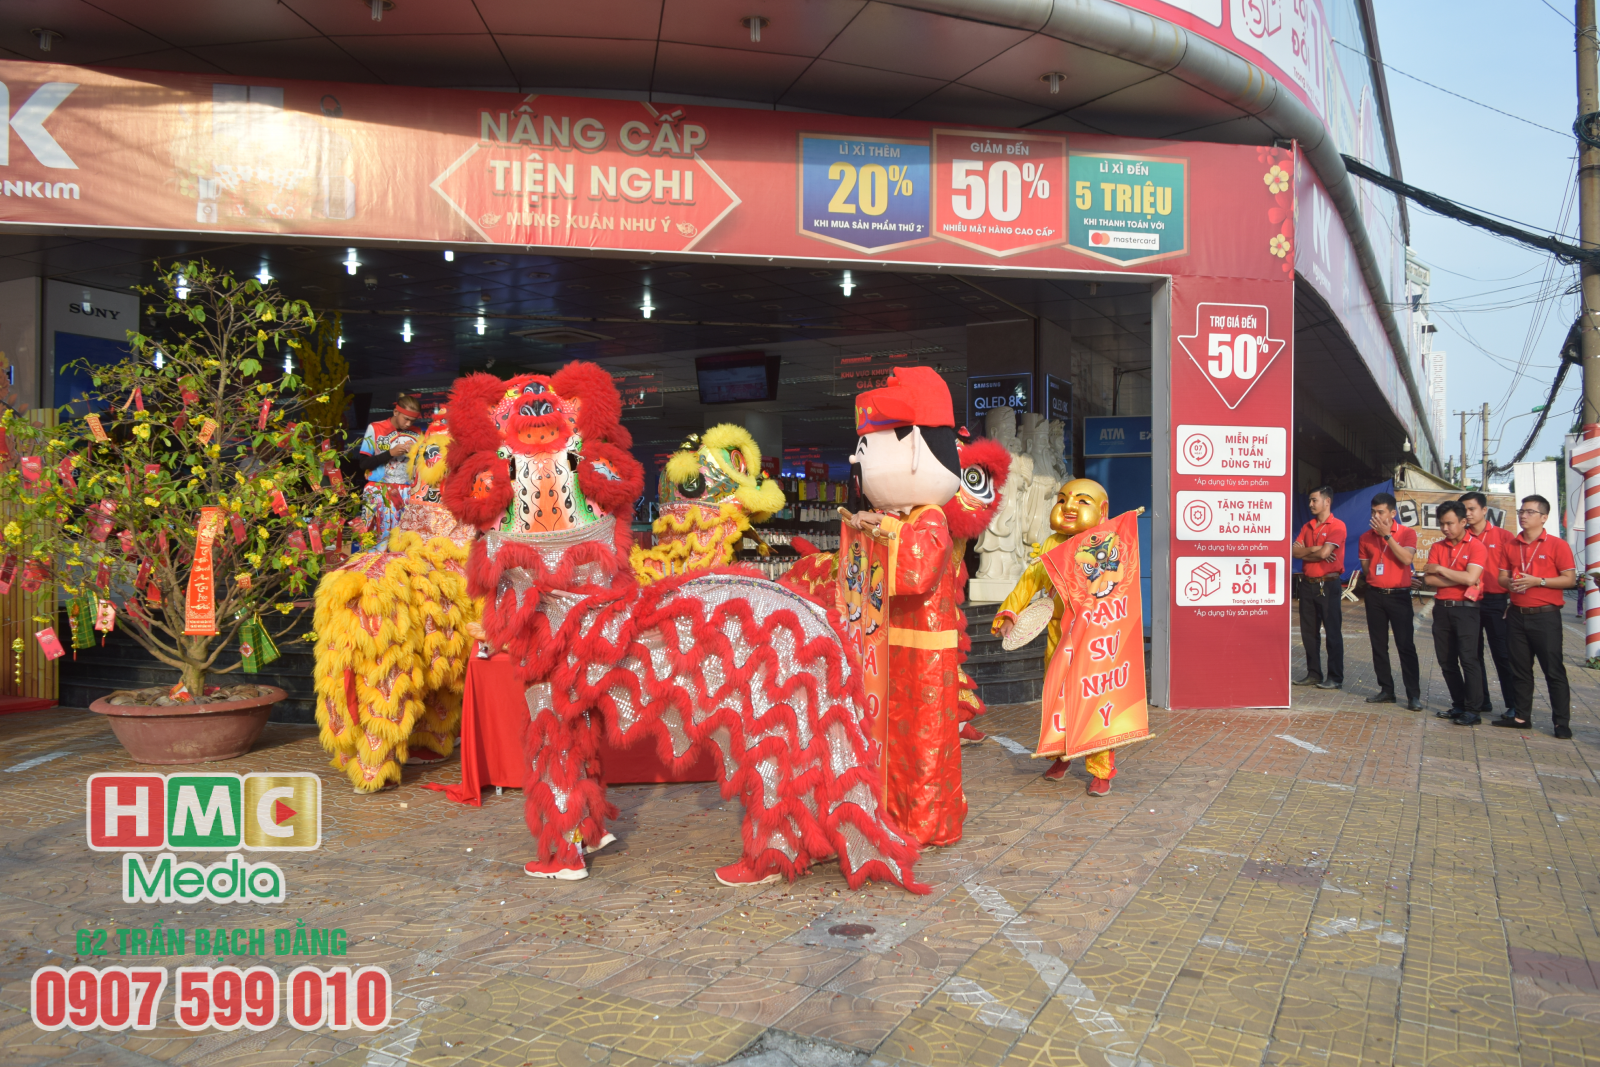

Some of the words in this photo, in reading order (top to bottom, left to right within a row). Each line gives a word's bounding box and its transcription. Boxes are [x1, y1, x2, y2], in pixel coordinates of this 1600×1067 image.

[480, 105, 606, 149] NÂNG
[619, 108, 707, 155] CẤP
[839, 142, 849, 155] LÌ
[852, 142, 866, 156] XÌ
[869, 145, 901, 158] THÊM
[970, 140, 1003, 154] GIẢM
[1006, 142, 1030, 156] ĐẾN
[1099, 160, 1109, 173] LÌ
[1112, 161, 1124, 175] XÌ
[1127, 162, 1149, 176] ĐẾN
[489, 152, 574, 202] TIỆN
[590, 165, 694, 201] NGHI
[827, 161, 914, 217] 20%
[951, 158, 1050, 222] 50%
[1075, 180, 1092, 211] 5
[1100, 180, 1172, 220] TRIỆU
[565, 212, 614, 230] XUÂN
[620, 215, 657, 232] NHƯ
[661, 216, 671, 233] Ý
[814, 219, 829, 228] KHI
[831, 220, 850, 229] MUA
[852, 219, 870, 230] SẢN
[871, 220, 897, 231] PHẨM
[899, 222, 915, 232] THỨ
[943, 221, 968, 232] NHIỀU
[969, 224, 987, 235] MẶT
[988, 224, 1013, 235] HÀNG
[1015, 227, 1034, 236] CAO
[1083, 217, 1098, 226] KHI
[1099, 219, 1126, 228] THANH
[1127, 219, 1149, 229] TOÁN
[1151, 221, 1165, 230] VỚI
[1113, 235, 1157, 245] mastercard
[69, 302, 121, 320] SONY
[1209, 315, 1226, 330] TRỢ
[1227, 315, 1240, 329] GIÁ
[1241, 314, 1257, 329] ĐẾN
[1208, 333, 1269, 380] 50%
[856, 378, 873, 390] GIÁ
[875, 376, 888, 388] SỐ
[973, 382, 1001, 390] SAMSUNG
[974, 396, 1007, 410] QLED
[1008, 395, 1024, 408] 8K
[1099, 427, 1126, 441] ATM
[1225, 431, 1249, 445] MIỄN
[1252, 433, 1269, 445] PHÍ
[1229, 447, 1234, 456] 1
[1238, 444, 1264, 457] TUẦN
[1221, 457, 1250, 469] DÙNG
[1252, 457, 1272, 470] THỬ
[1208, 478, 1225, 487] dụng
[1226, 478, 1237, 487] tùy
[1217, 498, 1245, 512] TẶNG
[1247, 498, 1273, 510] THÊM
[1230, 512, 1234, 522] 1
[1238, 510, 1261, 522] NĂM
[1219, 521, 1240, 534] BẢO
[1243, 522, 1271, 534] HÀNH
[1208, 543, 1225, 552] dụng
[1226, 543, 1237, 552] tùy
[1235, 558, 1257, 576] LỖI
[1231, 575, 1257, 594] ĐỔI
[1263, 561, 1277, 595] 1
[1208, 609, 1225, 618] dụng
[1226, 609, 1237, 618] tùy
[1089, 629, 1121, 667] SỰ
[1081, 662, 1130, 699] NHƯ
[1098, 702, 1114, 729] Ý
